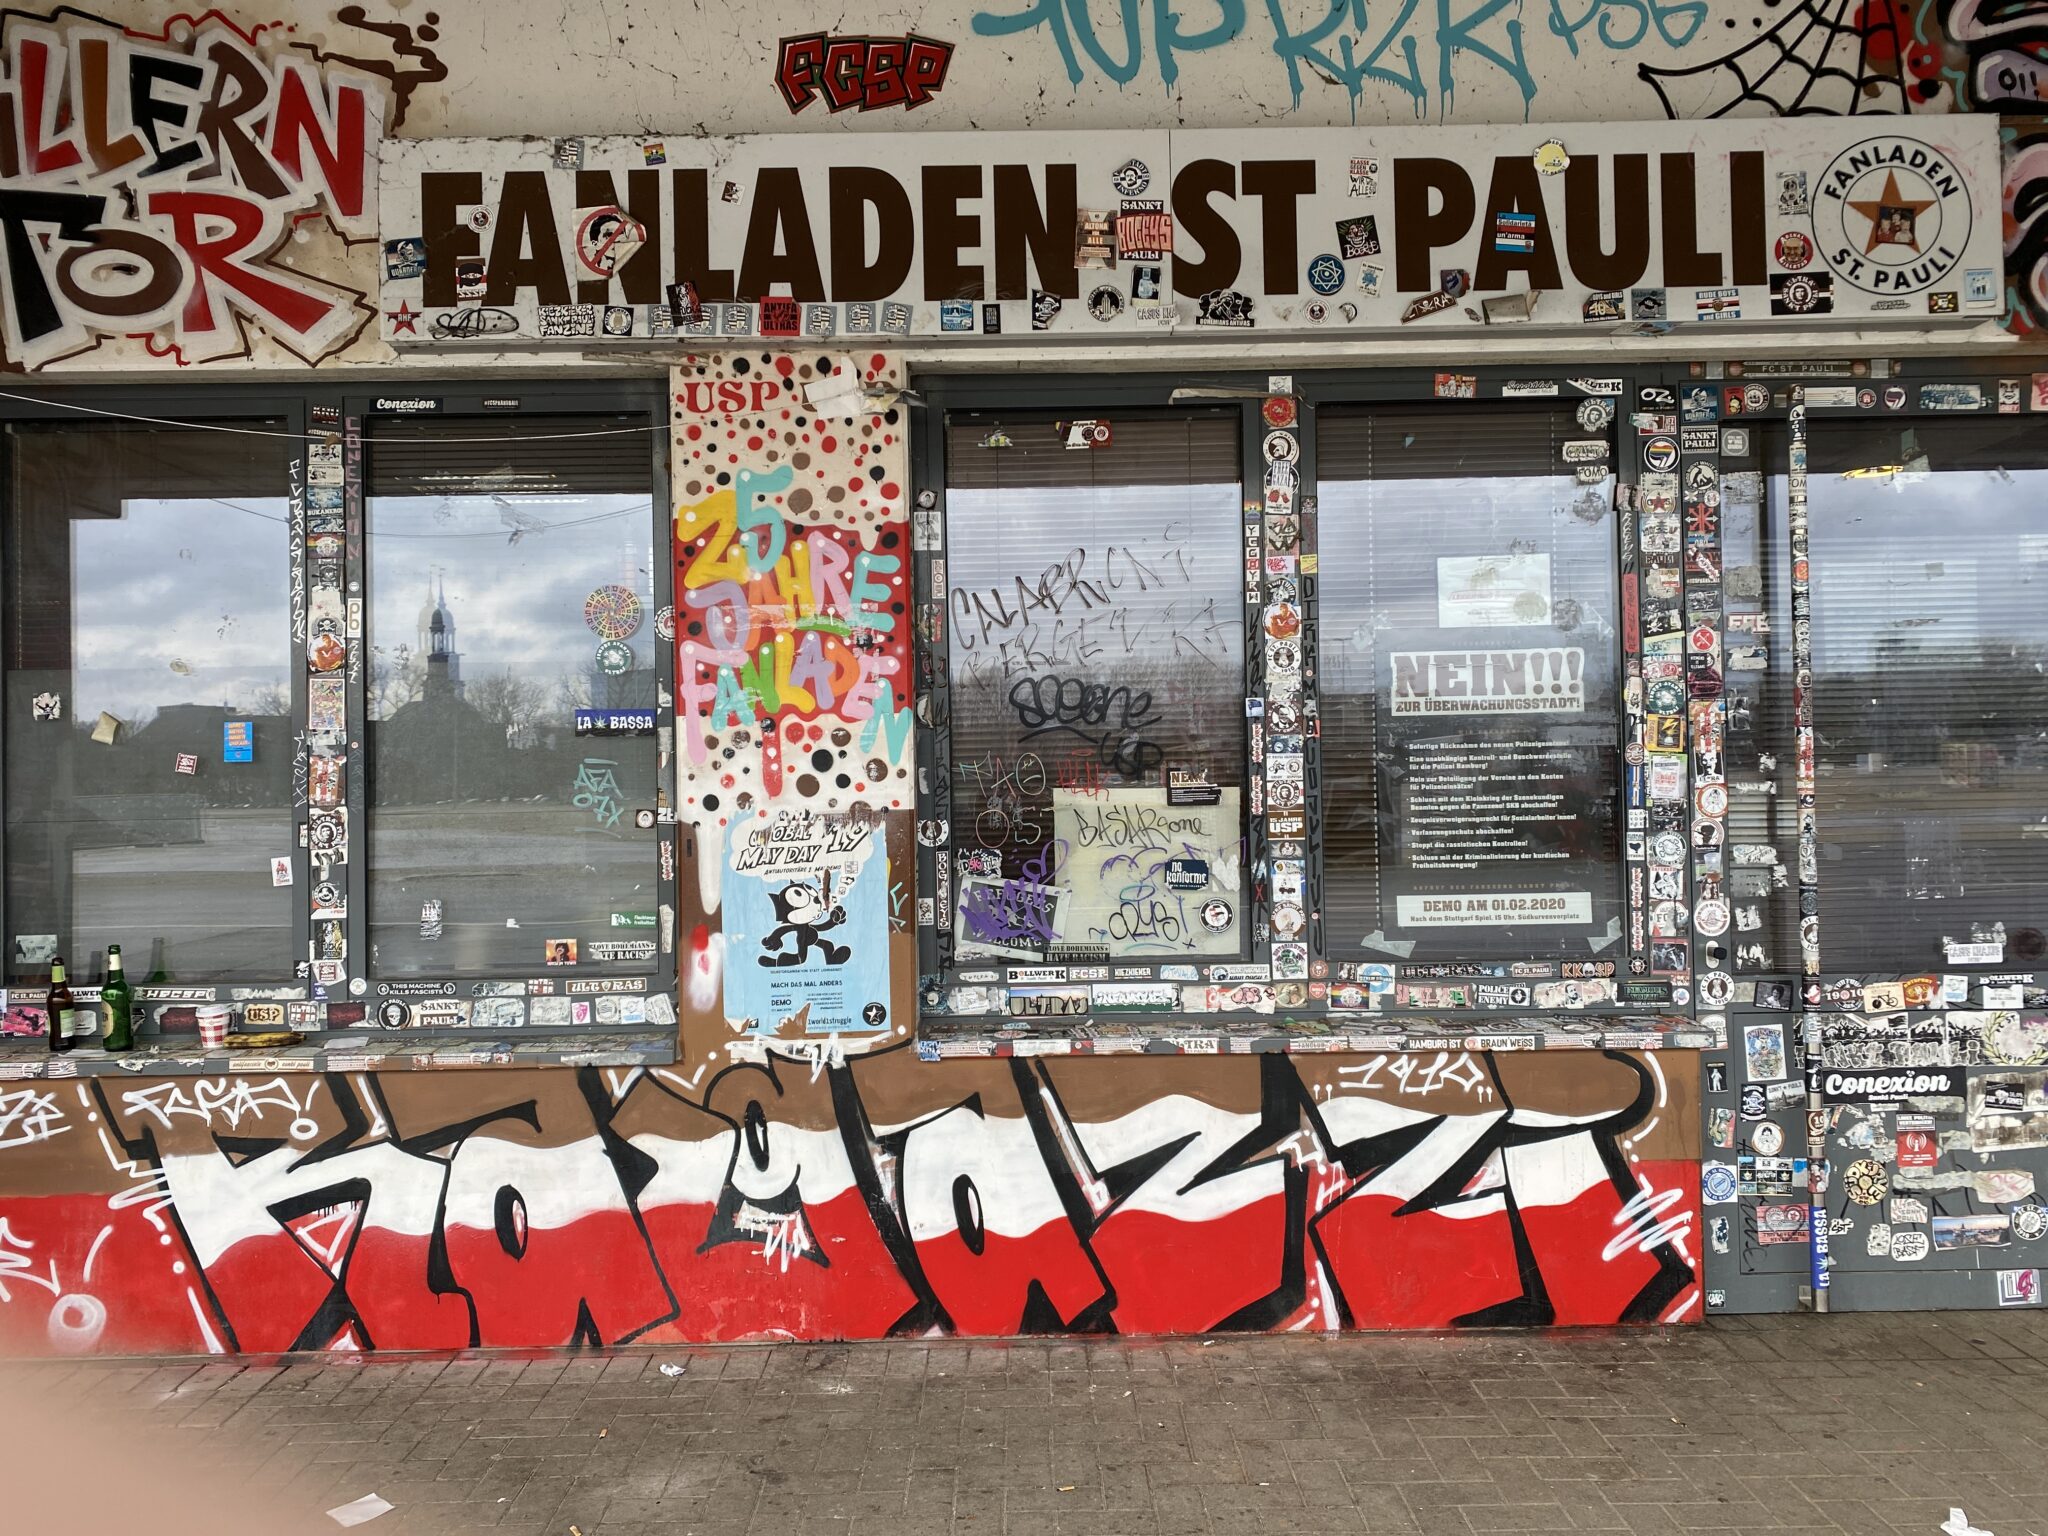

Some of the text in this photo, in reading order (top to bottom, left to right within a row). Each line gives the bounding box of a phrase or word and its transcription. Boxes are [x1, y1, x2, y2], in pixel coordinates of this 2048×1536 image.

[776, 32, 954, 112] FCSP
[1824, 136, 1959, 201] FANLADEN
[1122, 200, 1162, 209] SANKT
[421, 150, 1768, 308] FANLADEN ST PAULI
[1117, 215, 1172, 251] BOGEYS
[0, 190, 338, 343] TOR
[1832, 248, 1863, 282] ST.
[1873, 246, 1956, 291] PAULI
[763, 302, 798, 313] ANTIFA
[763, 321, 799, 331] ULTRAS
[684, 380, 780, 414] USP
[376, 397, 436, 410] Conexion
[1682, 432, 1717, 440] SANKT
[1684, 440, 1716, 448] PAULI
[1393, 650, 1583, 698] NEIN!!!
[1395, 697, 1581, 713] ZUR ÜBERWACHUNGSSTADT!
[577, 715, 654, 731] LA BASSA
[1456, 762, 1488, 770] Hamburg!
[1277, 815, 1304, 823] JAHRE
[1269, 822, 1304, 834] USP
[736, 845, 821, 871] MAY DAY
[1172, 861, 1183, 873] no
[1166, 870, 1207, 884] konforme
[1423, 898, 1566, 912] DEMO AM 01.02.2020
[1444, 914, 1473, 922] Stuttgart
[1517, 913, 1580, 921] Südkurvenvorplatz
[1046, 954, 1107, 962] HATE RACISM
[1008, 968, 1066, 980] BOLLWERK
[1478, 984, 1509, 993] POLICE
[1478, 995, 1509, 1005] ENEMY
[420, 1002, 460, 1011] SANKT
[249, 1005, 281, 1021] USP
[422, 1016, 459, 1025] PAULI
[1409, 1039, 1448, 1050] HAMBURG
[1480, 1038, 1508, 1048] BRAUN
[1825, 1070, 1951, 1095] Conexion
[1816, 1209, 1829, 1287] BASSA LA
